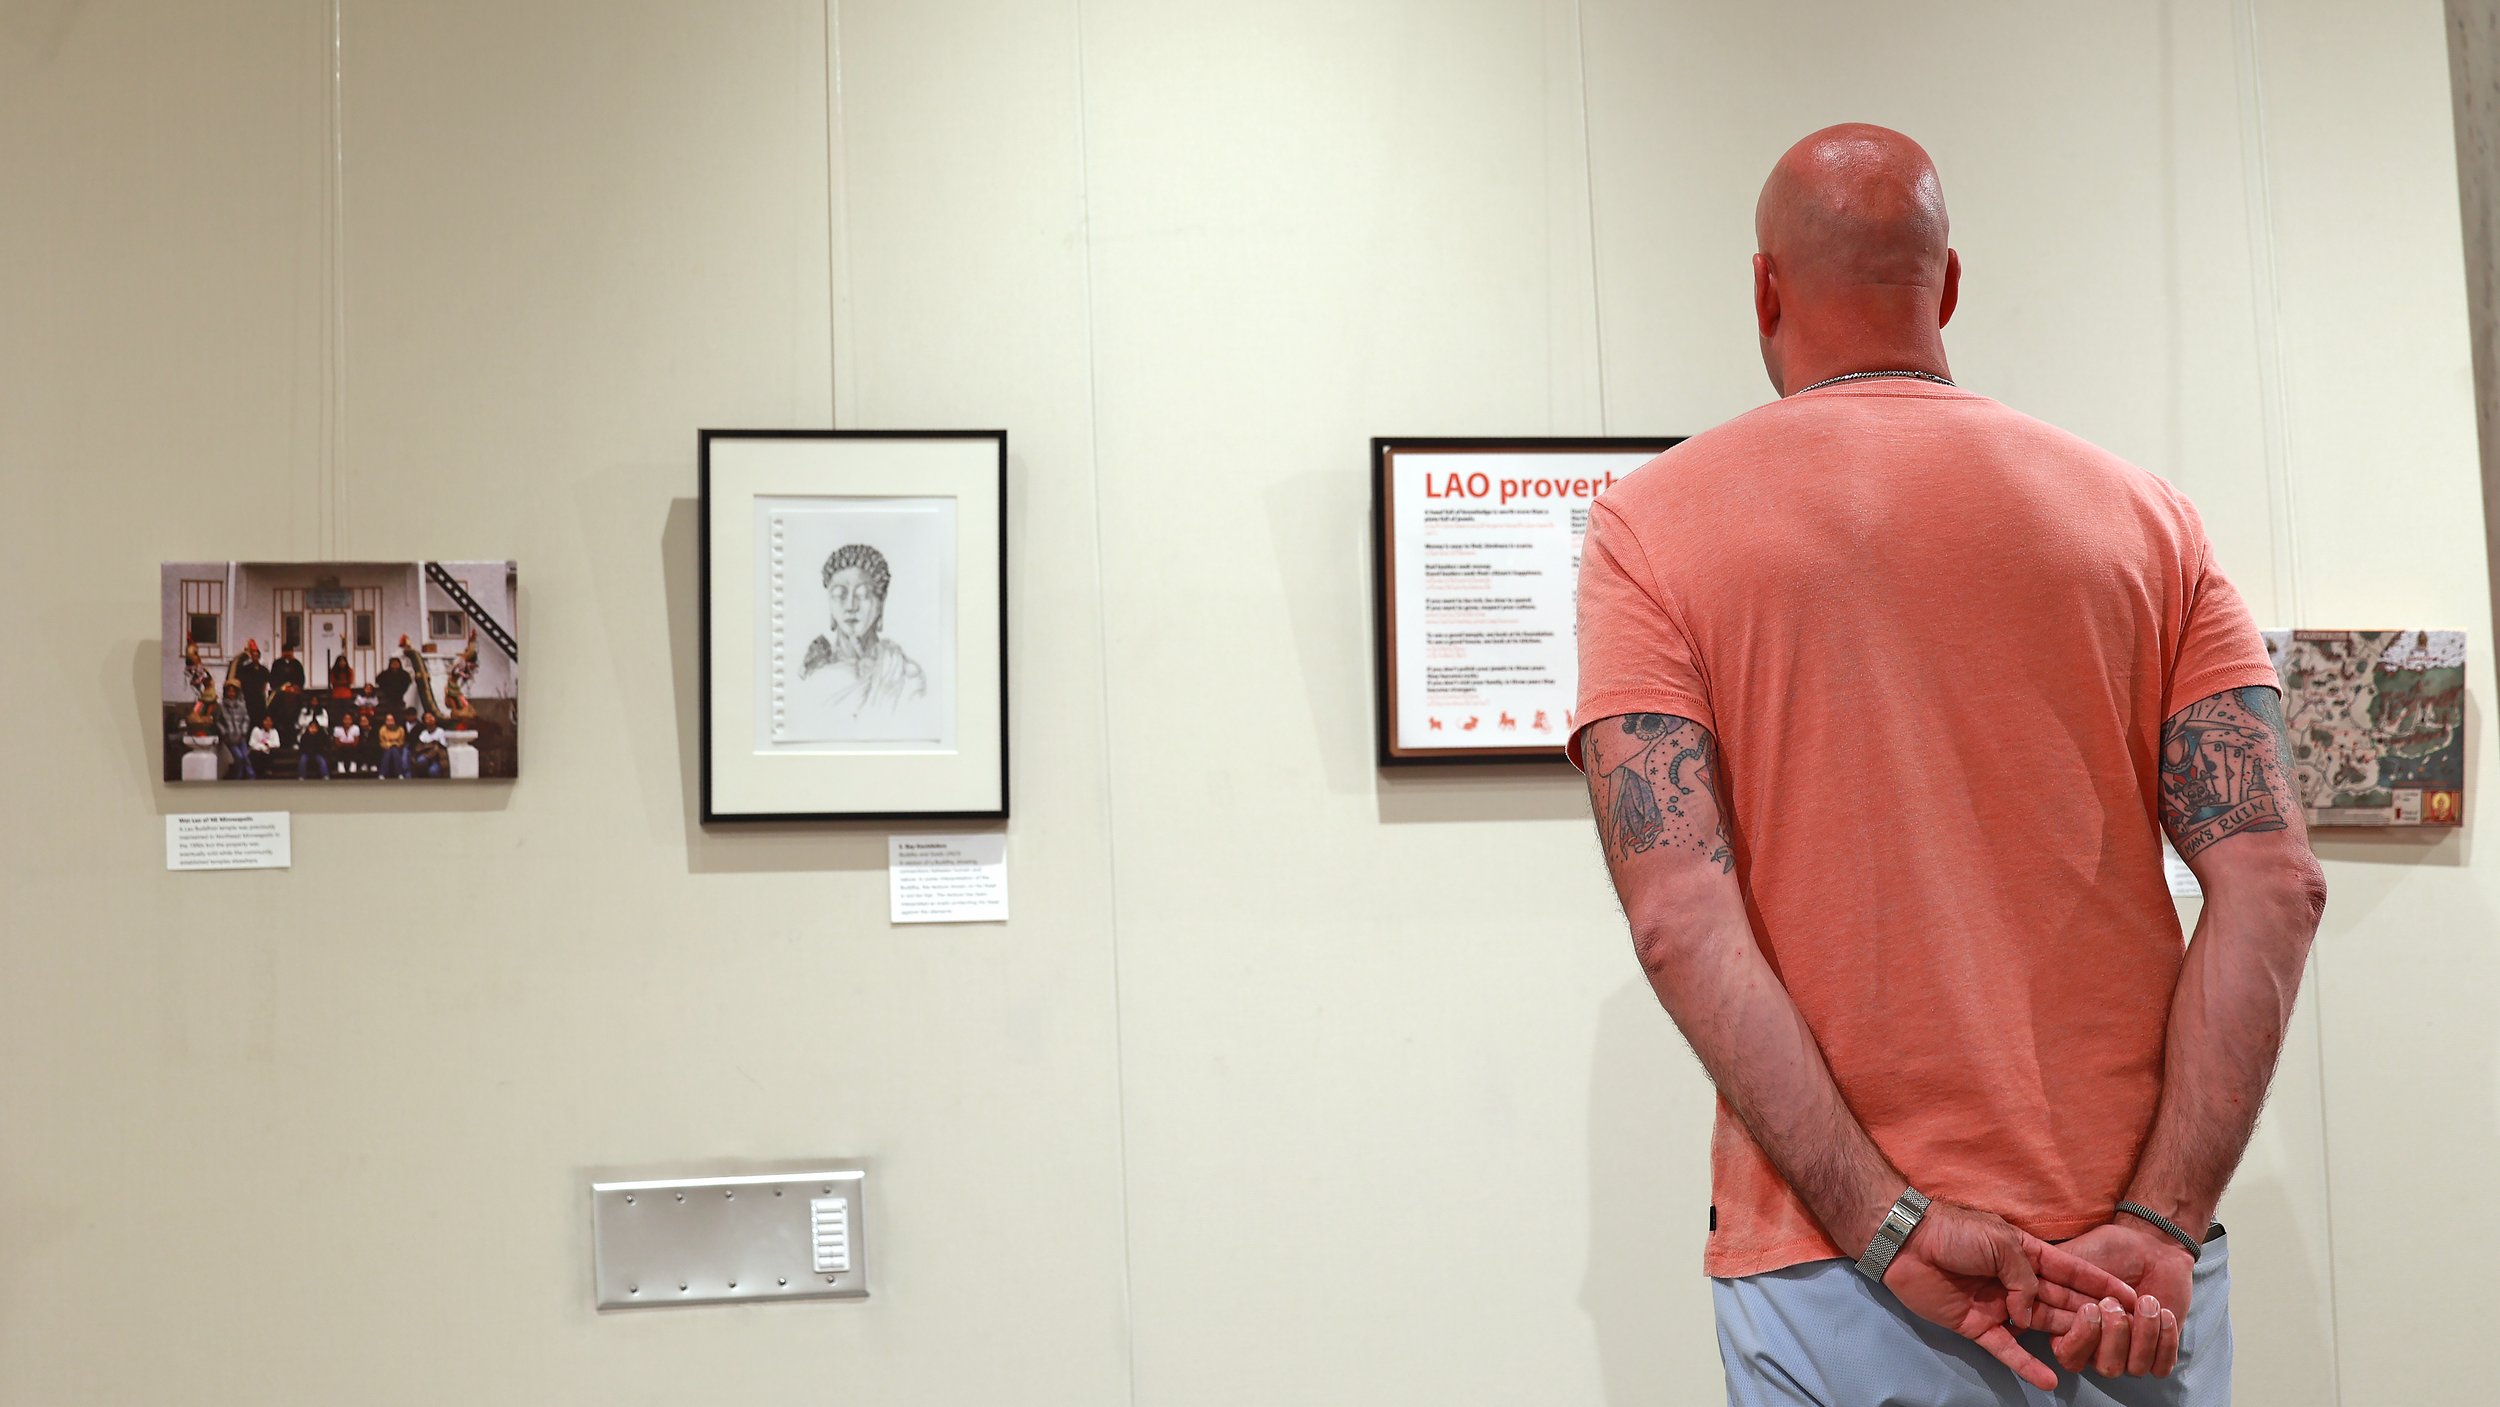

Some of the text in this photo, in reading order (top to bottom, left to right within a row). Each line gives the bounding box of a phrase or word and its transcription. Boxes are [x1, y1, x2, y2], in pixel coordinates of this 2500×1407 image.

[1425, 473, 1490, 498] LAO
[2184, 800, 2266, 854] MAN'S RUIN
